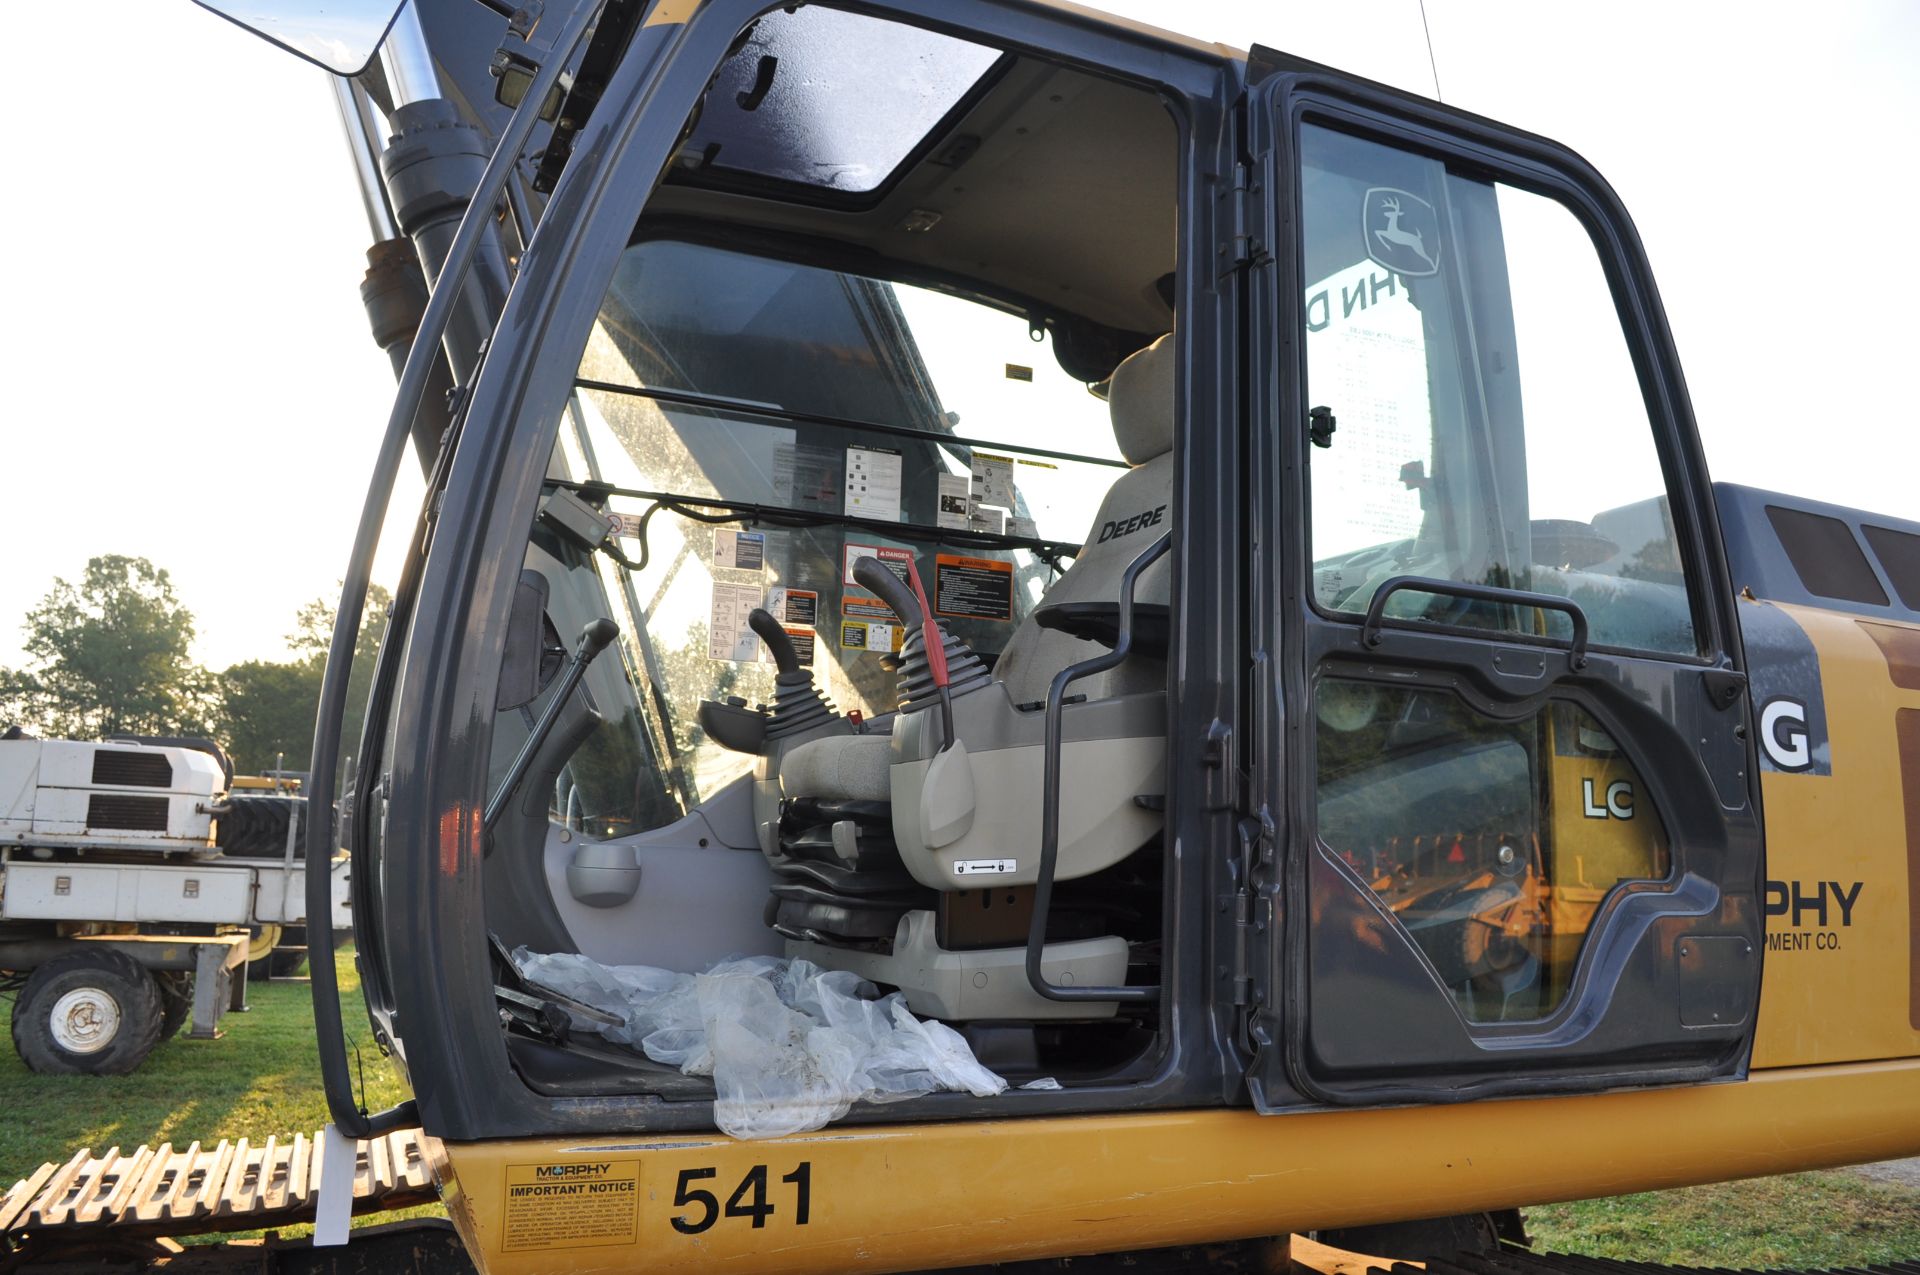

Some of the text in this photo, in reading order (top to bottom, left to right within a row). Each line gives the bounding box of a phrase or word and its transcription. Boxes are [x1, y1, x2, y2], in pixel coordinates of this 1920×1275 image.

[1097, 504, 1167, 544] DEERE
[885, 551, 910, 559] DANGER
[1759, 698, 1811, 771] G
[1583, 778, 1634, 819] LC
[1816, 932, 1841, 950] CO.
[537, 1164, 610, 1176] MURPHY
[510, 1182, 635, 1197] IMPORTANT NOTICE
[670, 1161, 811, 1234] 541
